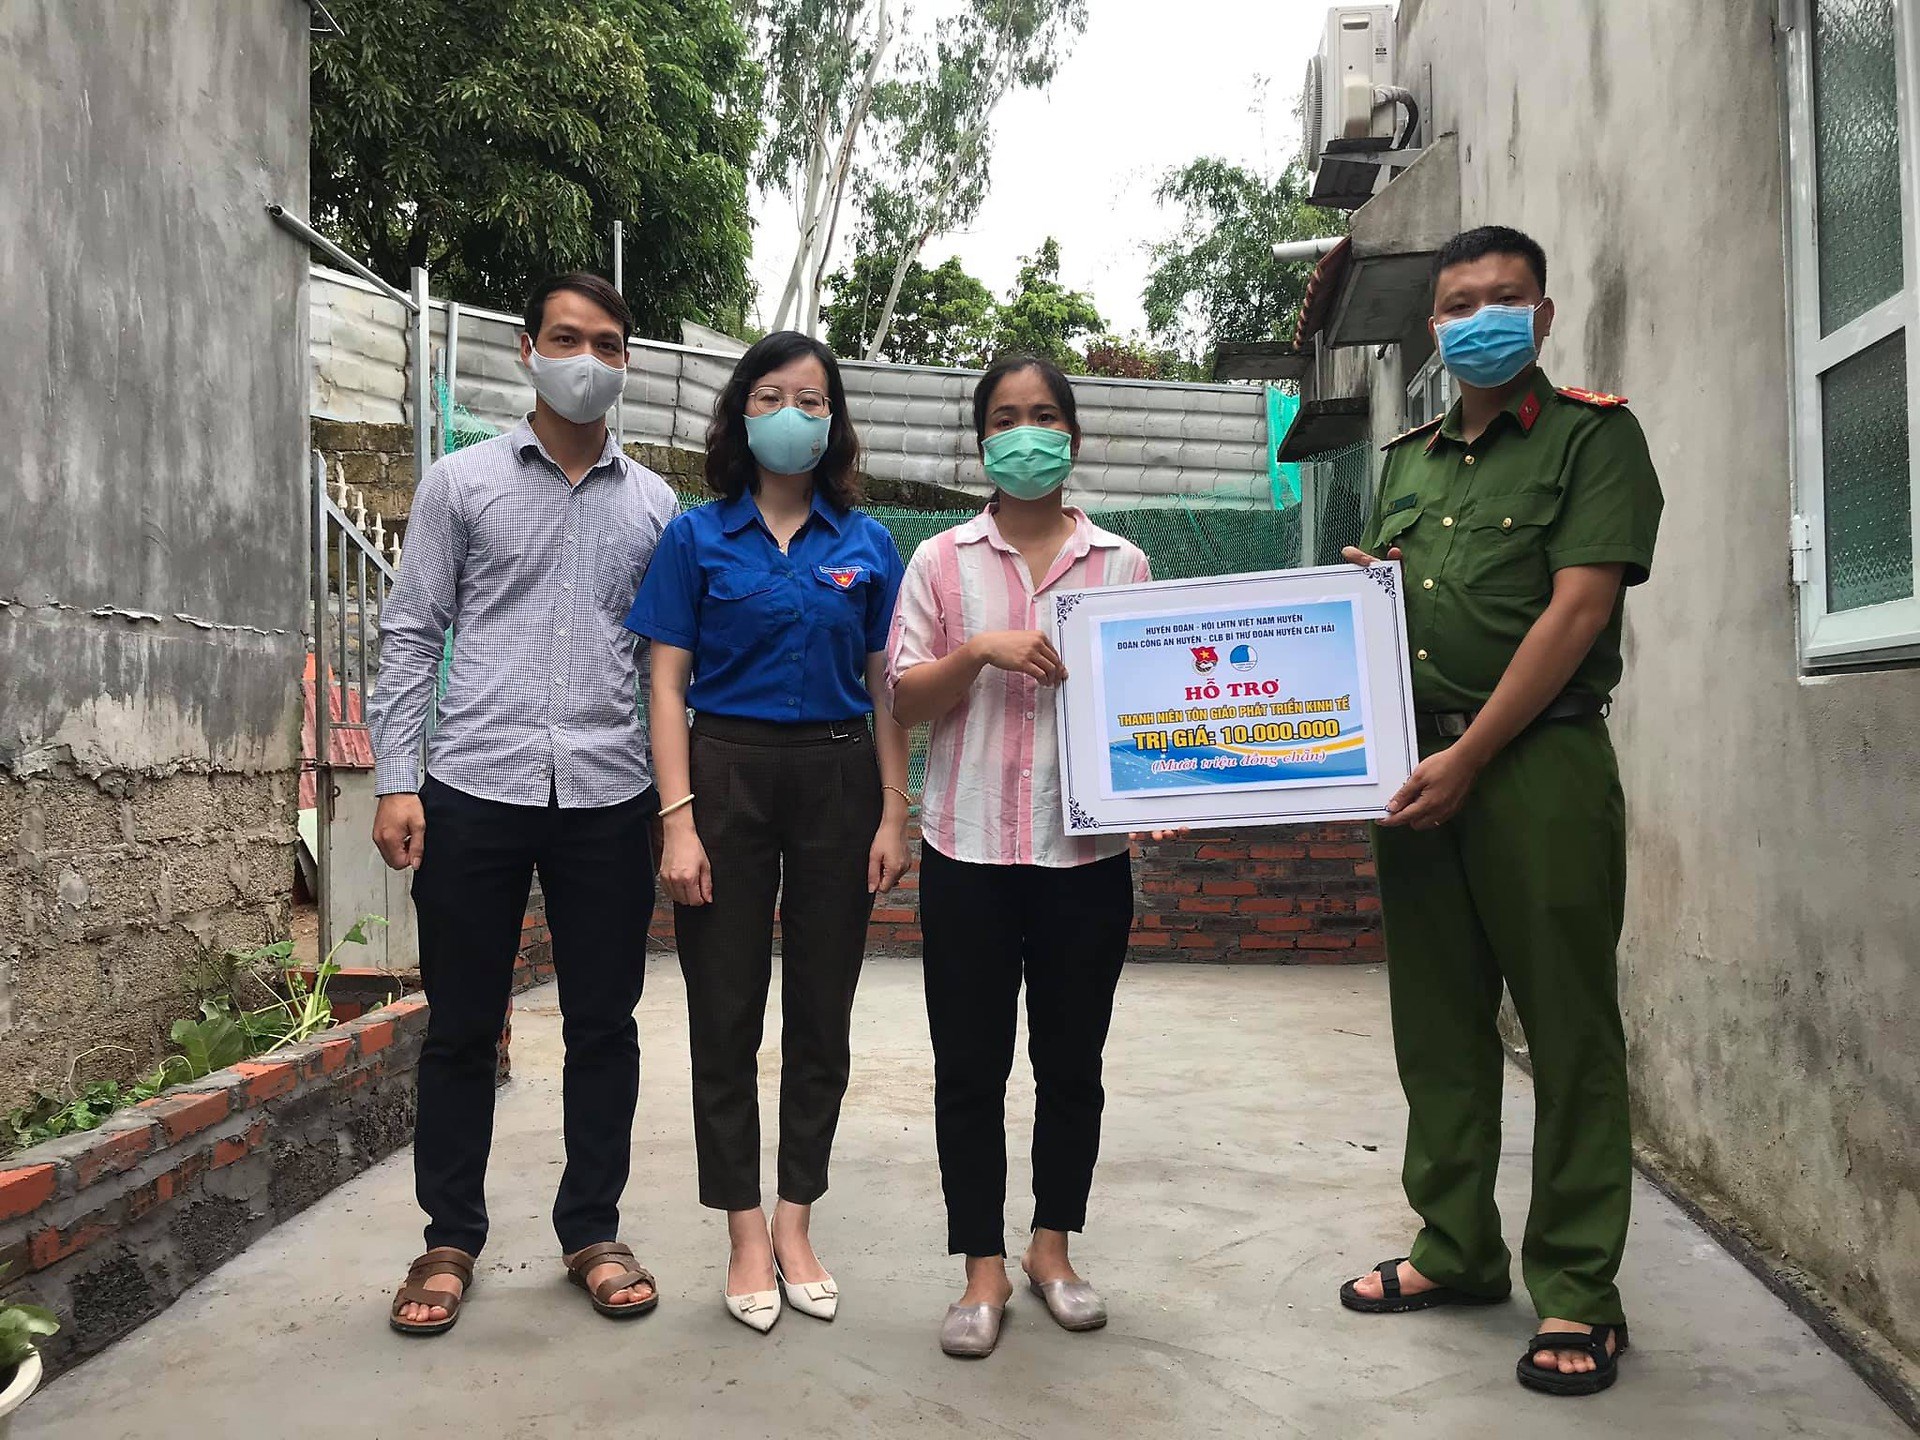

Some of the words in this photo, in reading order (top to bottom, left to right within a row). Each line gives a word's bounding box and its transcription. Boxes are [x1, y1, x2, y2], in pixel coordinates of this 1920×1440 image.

[1140, 637, 1161, 648] CÔNG
[1163, 637, 1174, 647] AN
[1209, 634, 1223, 643] CLB
[1236, 630, 1251, 640] THƯ
[1321, 622, 1335, 633] HẢI
[1216, 619, 1236, 629] LHTN
[1237, 617, 1254, 627] VIỆT
[1256, 616, 1275, 626] NAM
[1185, 678, 1220, 701] HỖ
[1226, 679, 1279, 700] TRỢ
[1118, 713, 1155, 727] THANH
[1156, 709, 1183, 724] NIÊN
[1185, 707, 1208, 722] TÔN
[1210, 705, 1236, 719] GIÁO
[1239, 702, 1268, 718] PHÁT
[1270, 698, 1303, 716] TRIỂN
[1305, 699, 1333, 714] KINH
[1335, 694, 1350, 711] TẾ
[1132, 730, 1168, 754] TRỊ
[1221, 718, 1340, 745] 10.000.000
[1151, 757, 1198, 773] (Mười
[1201, 756, 1238, 770] triệu
[1282, 749, 1326, 764] chẵn)
